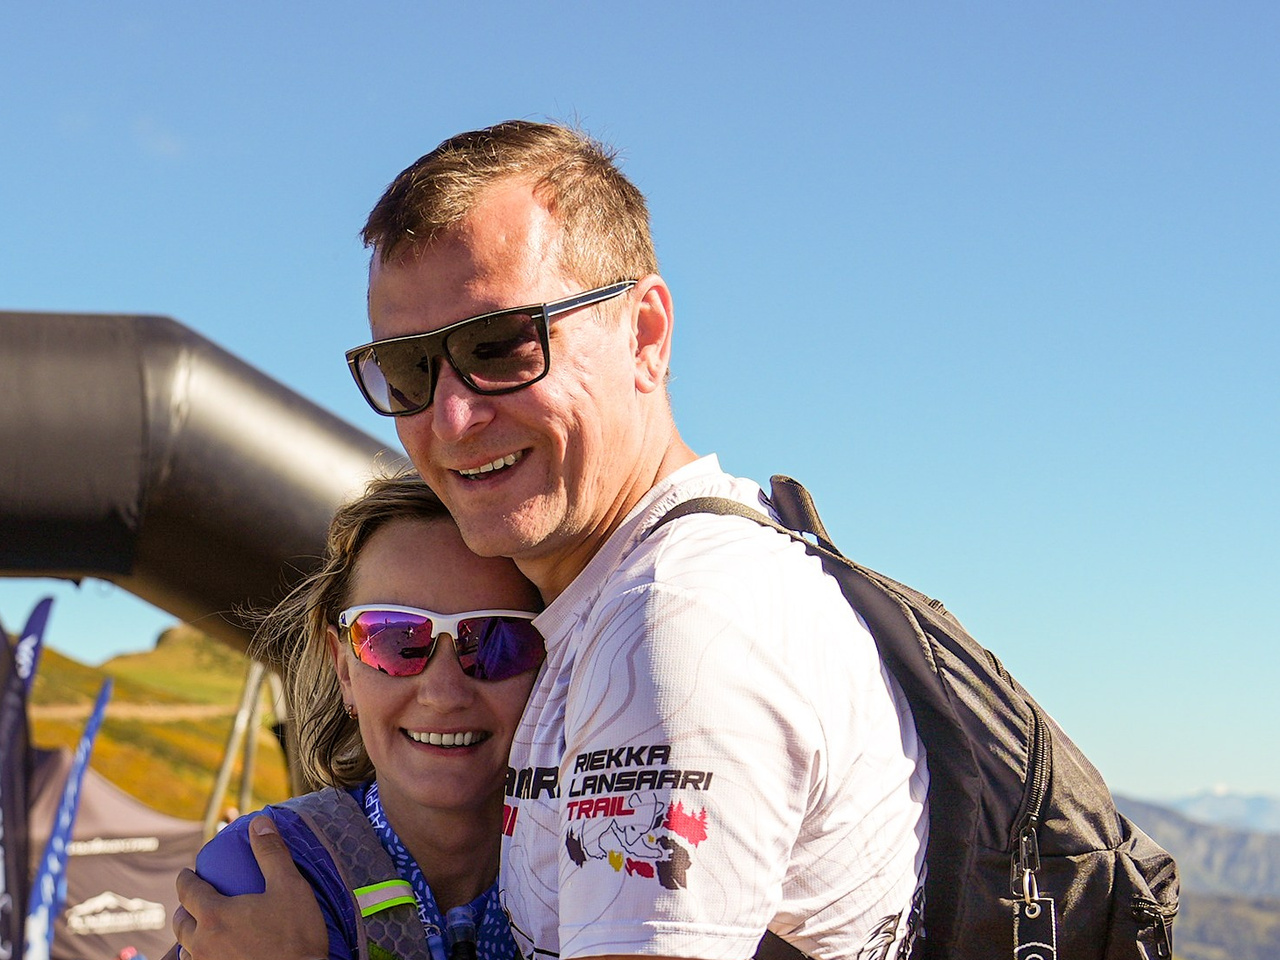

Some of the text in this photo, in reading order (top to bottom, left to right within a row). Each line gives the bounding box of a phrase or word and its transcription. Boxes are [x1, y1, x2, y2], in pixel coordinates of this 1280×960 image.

[573, 744, 672, 775] RIEKKA
[569, 769, 714, 798] LANSAARI
[566, 796, 636, 822] TRAIL
